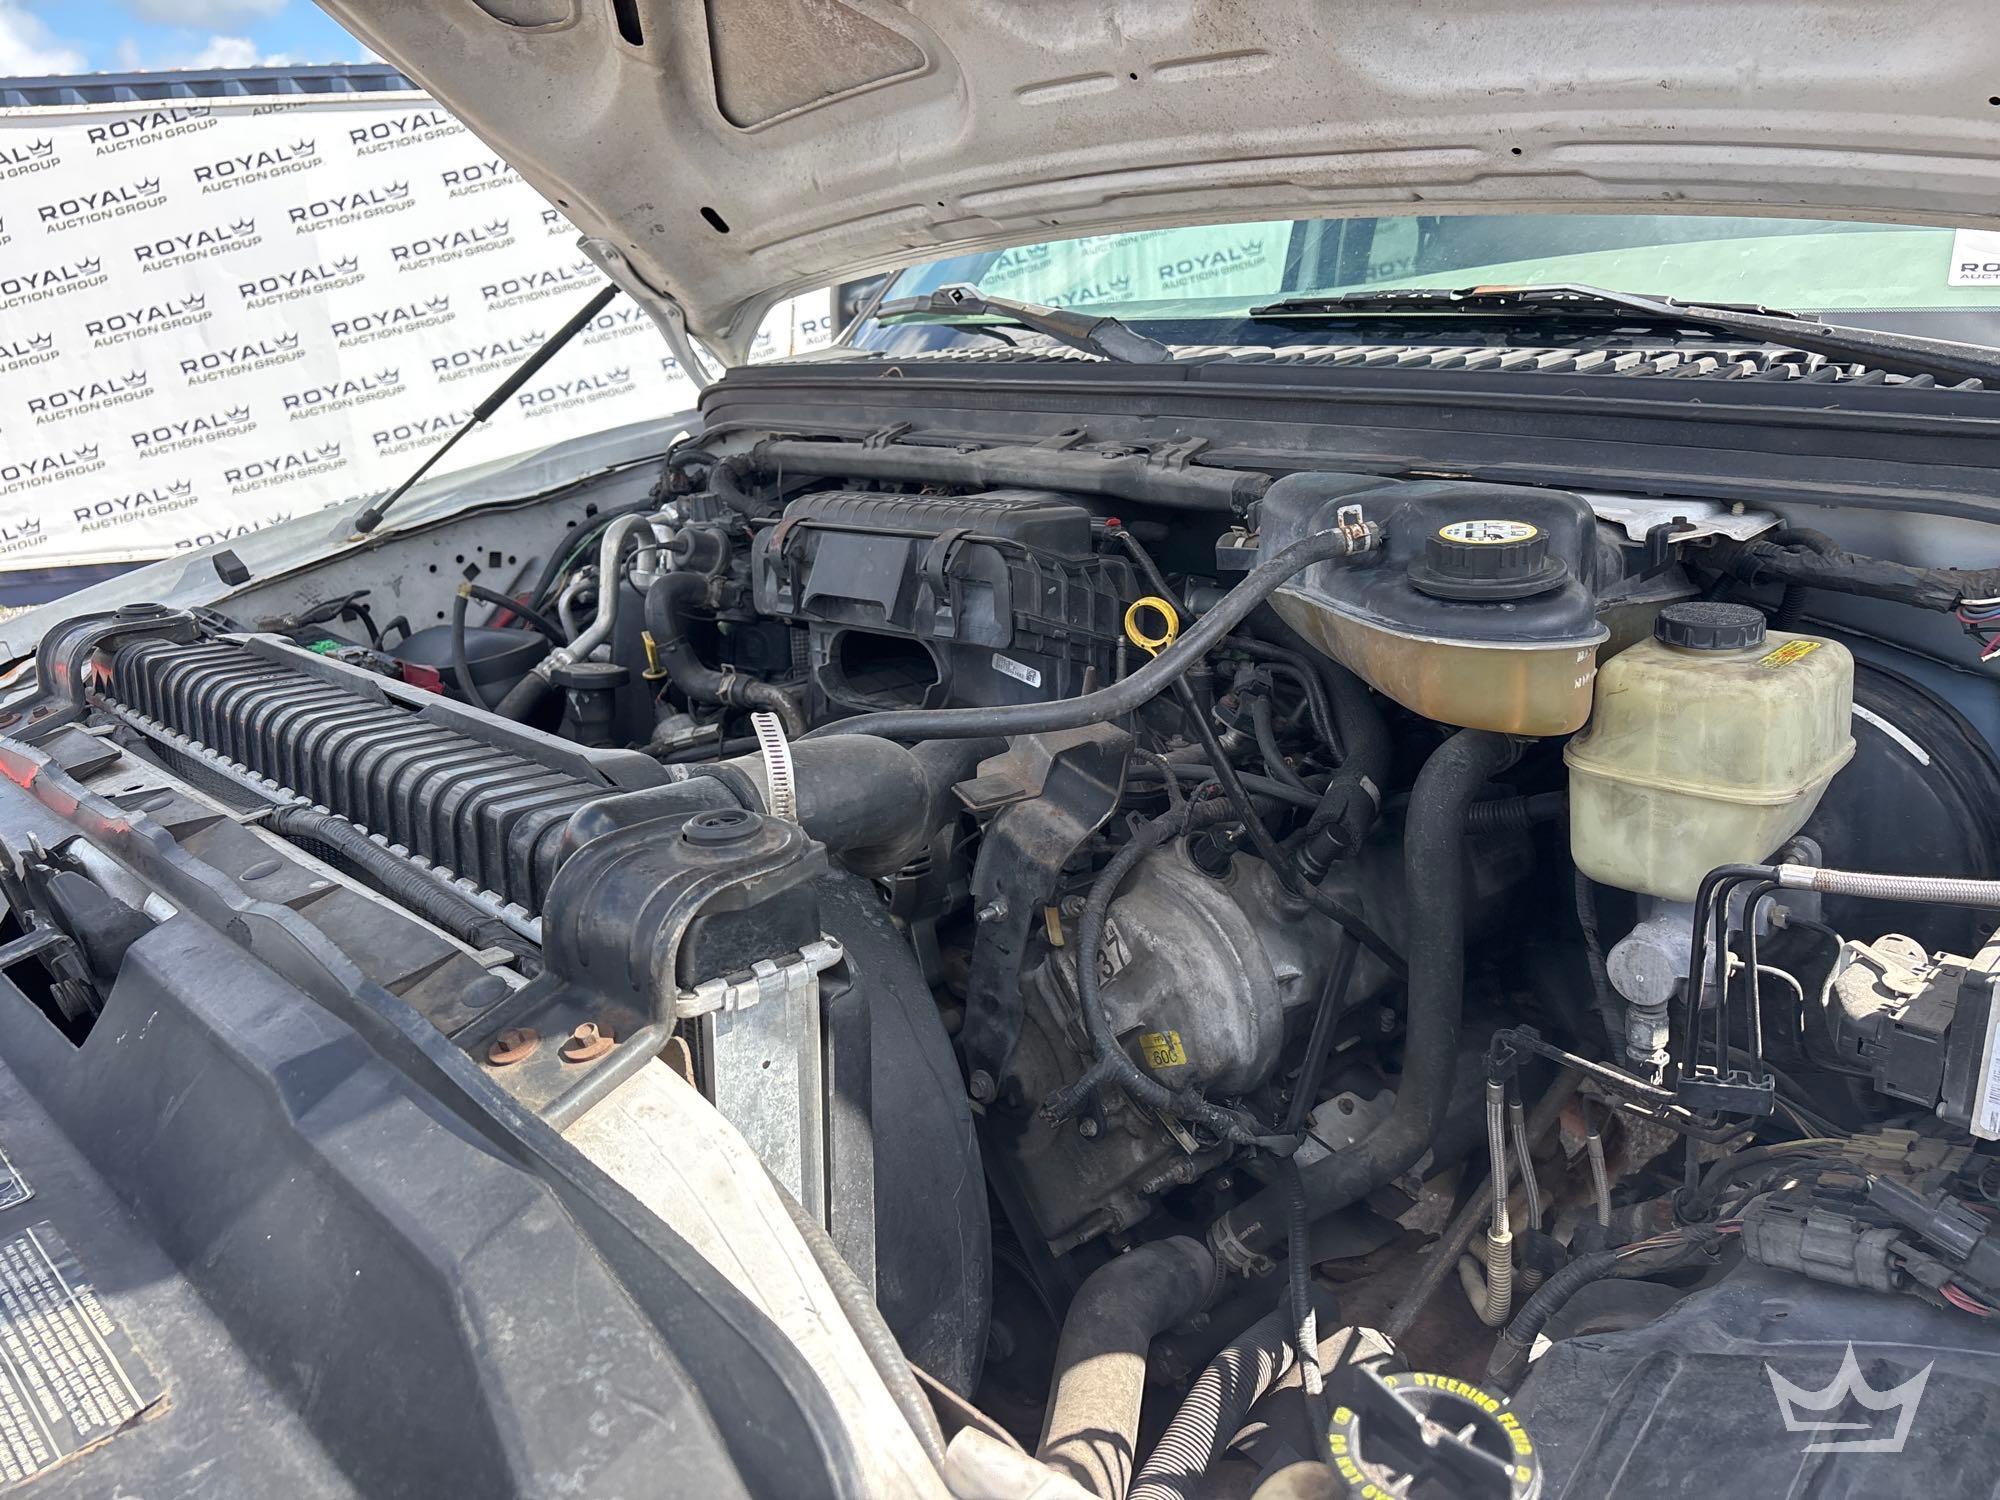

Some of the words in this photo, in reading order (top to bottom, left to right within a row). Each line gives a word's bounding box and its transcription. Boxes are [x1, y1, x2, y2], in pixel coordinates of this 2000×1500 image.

[87, 107, 188, 144] ROYAL
[95, 131, 164, 156] AUCTION
[165, 118, 218, 140] GROUP
[349, 111, 447, 145] ROYAL
[356, 133, 422, 157] AUCTION
[7, 157, 61, 178] GROUP
[194, 147, 292, 183] ROYAL
[201, 171, 268, 194] AUCTION
[270, 157, 323, 179] GROUP
[38, 181, 137, 222] ROYAL
[449, 175, 513, 199] AUCTION
[46, 209, 112, 234] AUCTION
[115, 195, 168, 217] GROUP
[288, 189, 385, 224] ROYAL
[295, 211, 362, 235] AUCTION
[364, 199, 416, 220] GROUP
[134, 226, 231, 262] ROYAL
[142, 250, 207, 273] AUCTION
[210, 235, 262, 257] GROUP
[390, 226, 486, 262] ROYAL
[398, 251, 463, 273] AUCTION
[465, 236, 516, 257] GROUP
[1, 265, 79, 296] OYAL
[239, 263, 335, 298] ROYAL
[1159, 247, 1242, 279] ROYAL
[0, 288, 54, 310] UCTION
[56, 274, 108, 296] GROUP
[246, 288, 312, 311] AUCTION
[313, 273, 365, 294] GROUP
[481, 266, 573, 301] ROYAL
[487, 290, 550, 312] AUCTION
[552, 275, 601, 295] GROUP
[1045, 284, 1110, 306] OYAL
[86, 301, 184, 337] ROYAL
[94, 325, 159, 348] AUCTION
[161, 310, 213, 332] GROUP
[331, 302, 427, 338] ROYAL
[338, 326, 403, 349] AUCTION
[405, 312, 456, 332] GROUP
[8, 350, 60, 371] GROUP
[180, 339, 276, 375] ROYAL
[187, 364, 252, 387] AUCTION
[255, 350, 306, 370] GROUP
[432, 340, 524, 372] ROYAL
[438, 360, 500, 384] AUCTION
[28, 380, 125, 413] ROYAL
[36, 402, 100, 425] AUCTION
[103, 387, 154, 409] GROUP
[283, 375, 378, 410] ROYAL
[289, 400, 353, 422] AUCTION
[355, 384, 406, 405] GROUP
[517, 376, 609, 408] ROYAL
[524, 397, 585, 419] AUCTION
[131, 413, 226, 449] ROYAL
[139, 436, 204, 459] AUCTION
[205, 422, 257, 443] GROUP
[372, 412, 466, 447] ROYAL
[0, 473, 53, 496] UCTION
[54, 460, 106, 481] GROUP
[1, 452, 76, 481] OYAL
[224, 449, 320, 483] ROYAL
[231, 473, 295, 495] AUCTION
[297, 458, 348, 479] GROUP
[74, 488, 169, 520] ROYAL
[81, 510, 145, 533] AUCTION
[147, 496, 199, 516] GROUP
[1414, 1373, 1500, 1413] STEERING
[1497, 1412, 1533, 1456] FLUID
